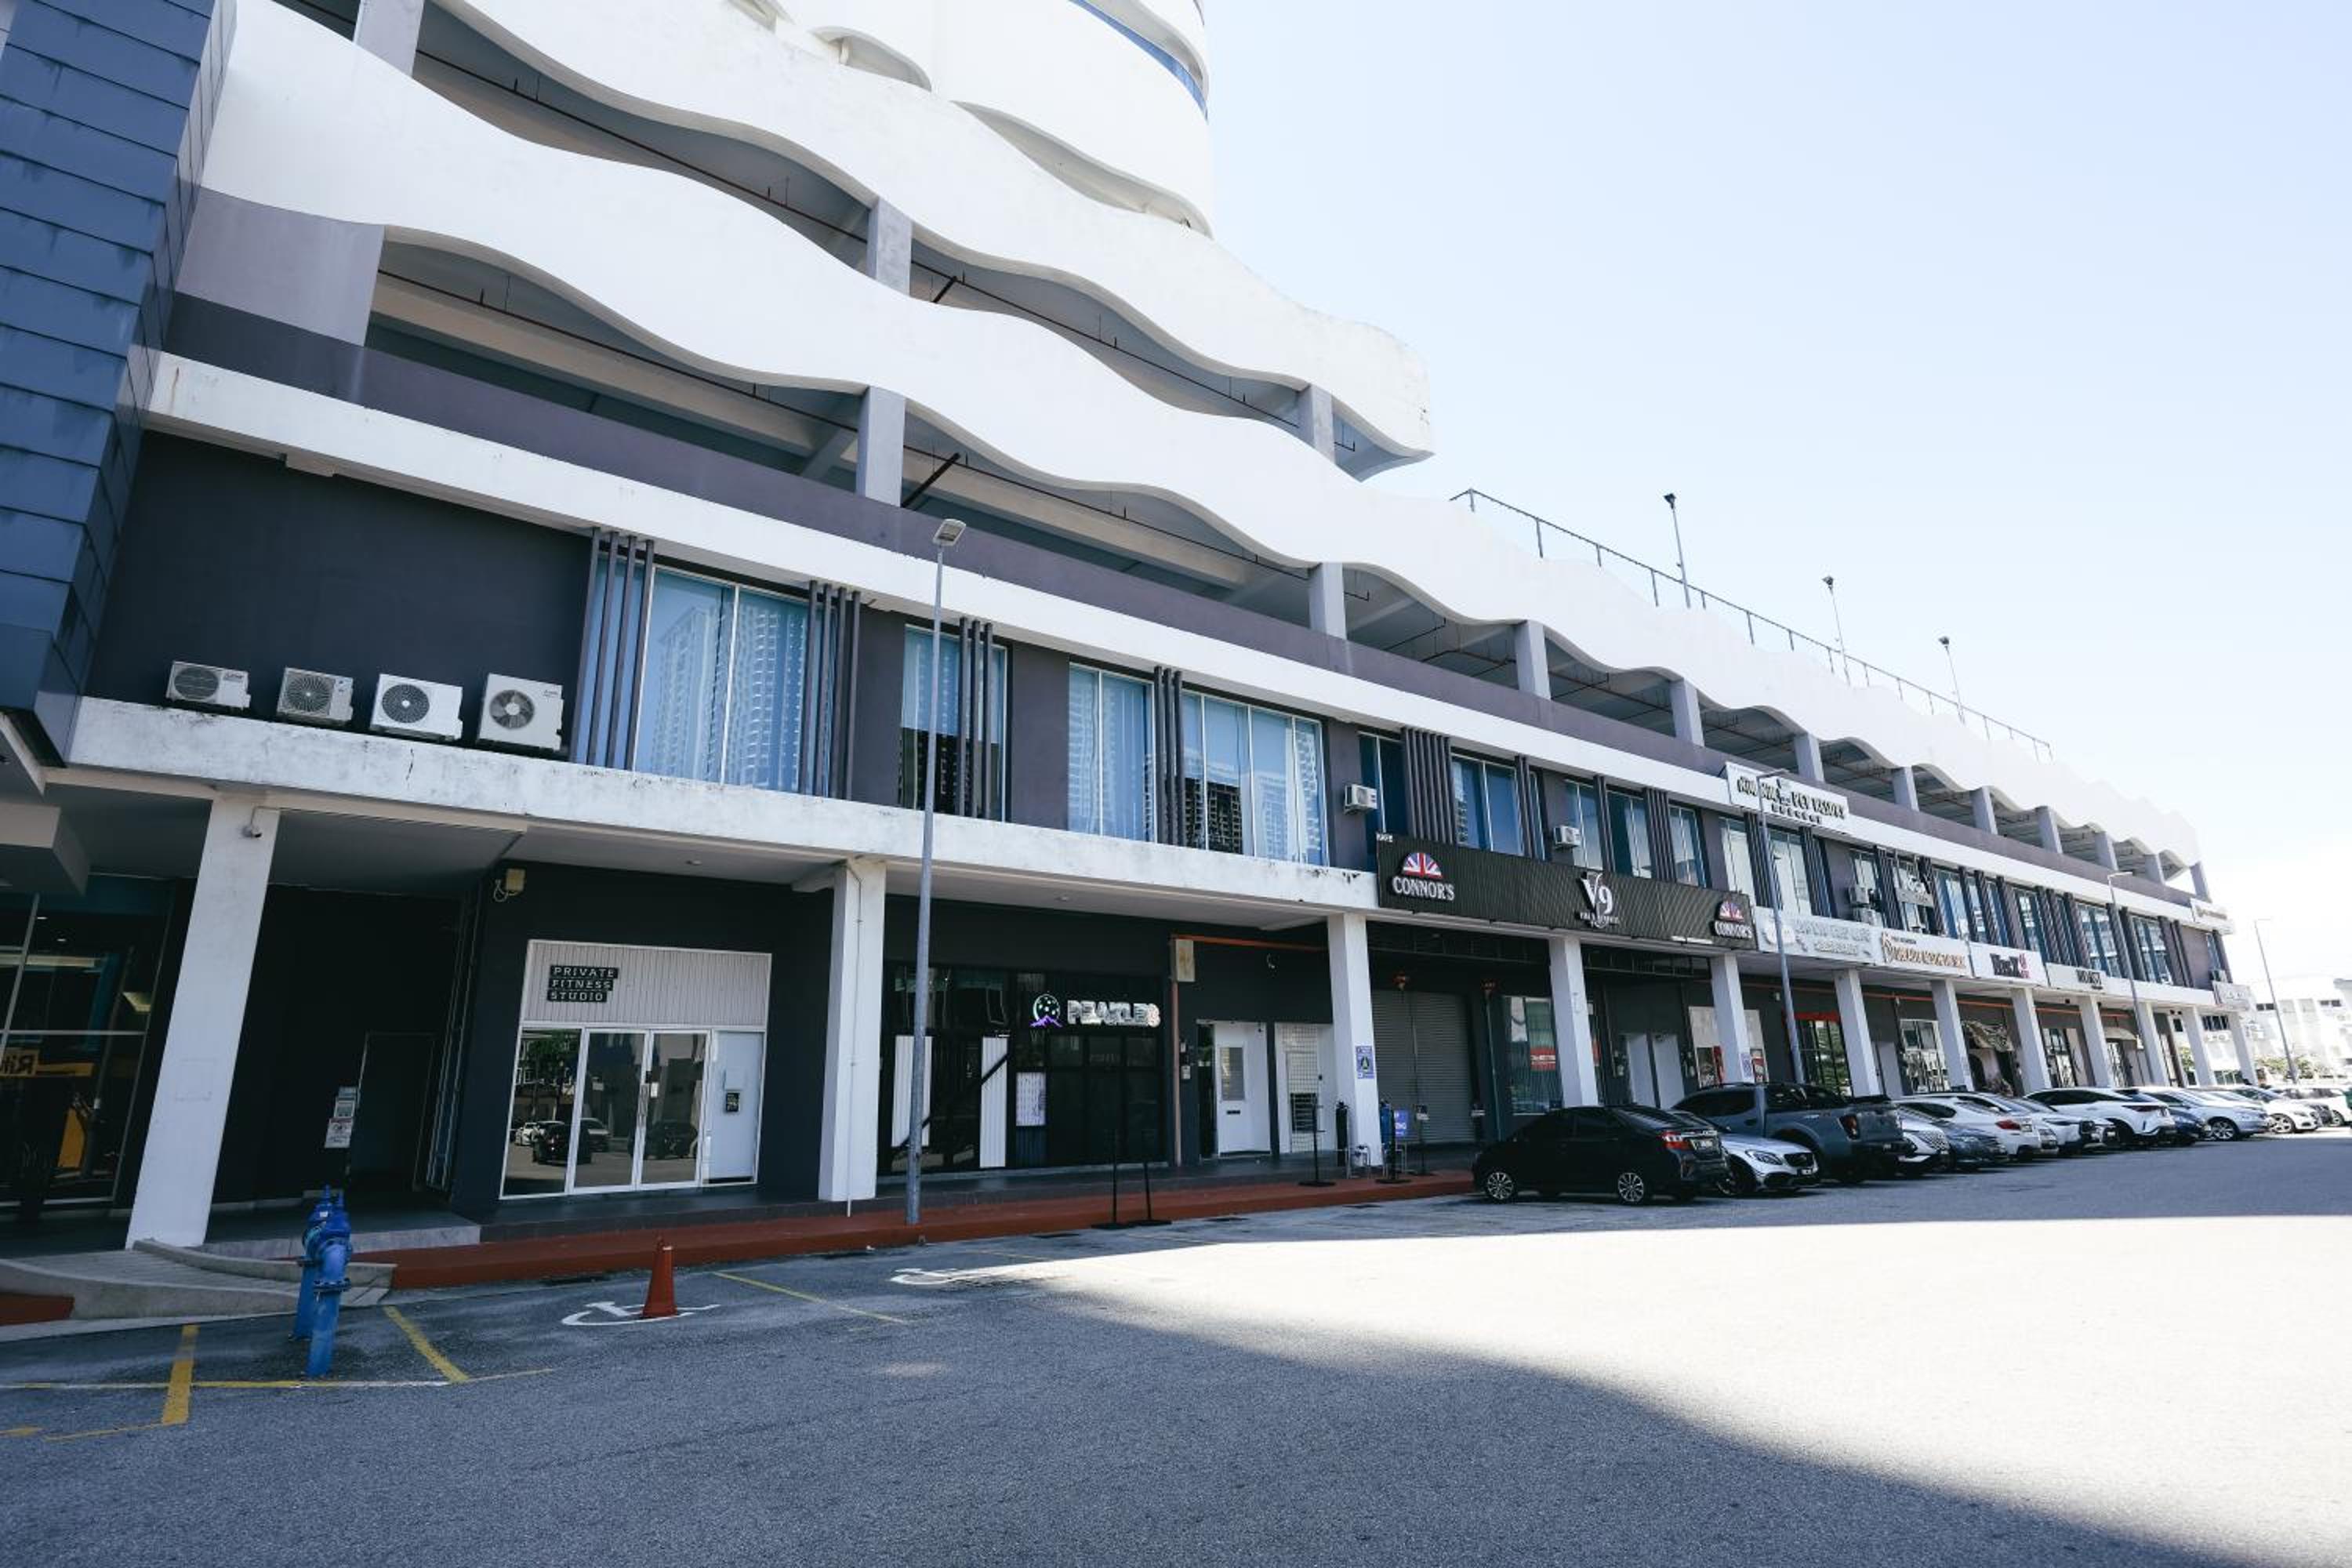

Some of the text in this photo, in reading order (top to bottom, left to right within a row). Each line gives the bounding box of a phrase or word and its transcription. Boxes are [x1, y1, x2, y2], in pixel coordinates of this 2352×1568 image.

[1392, 876, 1455, 901] CONNOR'S
[1581, 873, 1613, 916] V9
[554, 967, 614, 978] PRIVATE
[551, 979, 612, 989] FITNESS
[551, 992, 603, 1001] STUDIO
